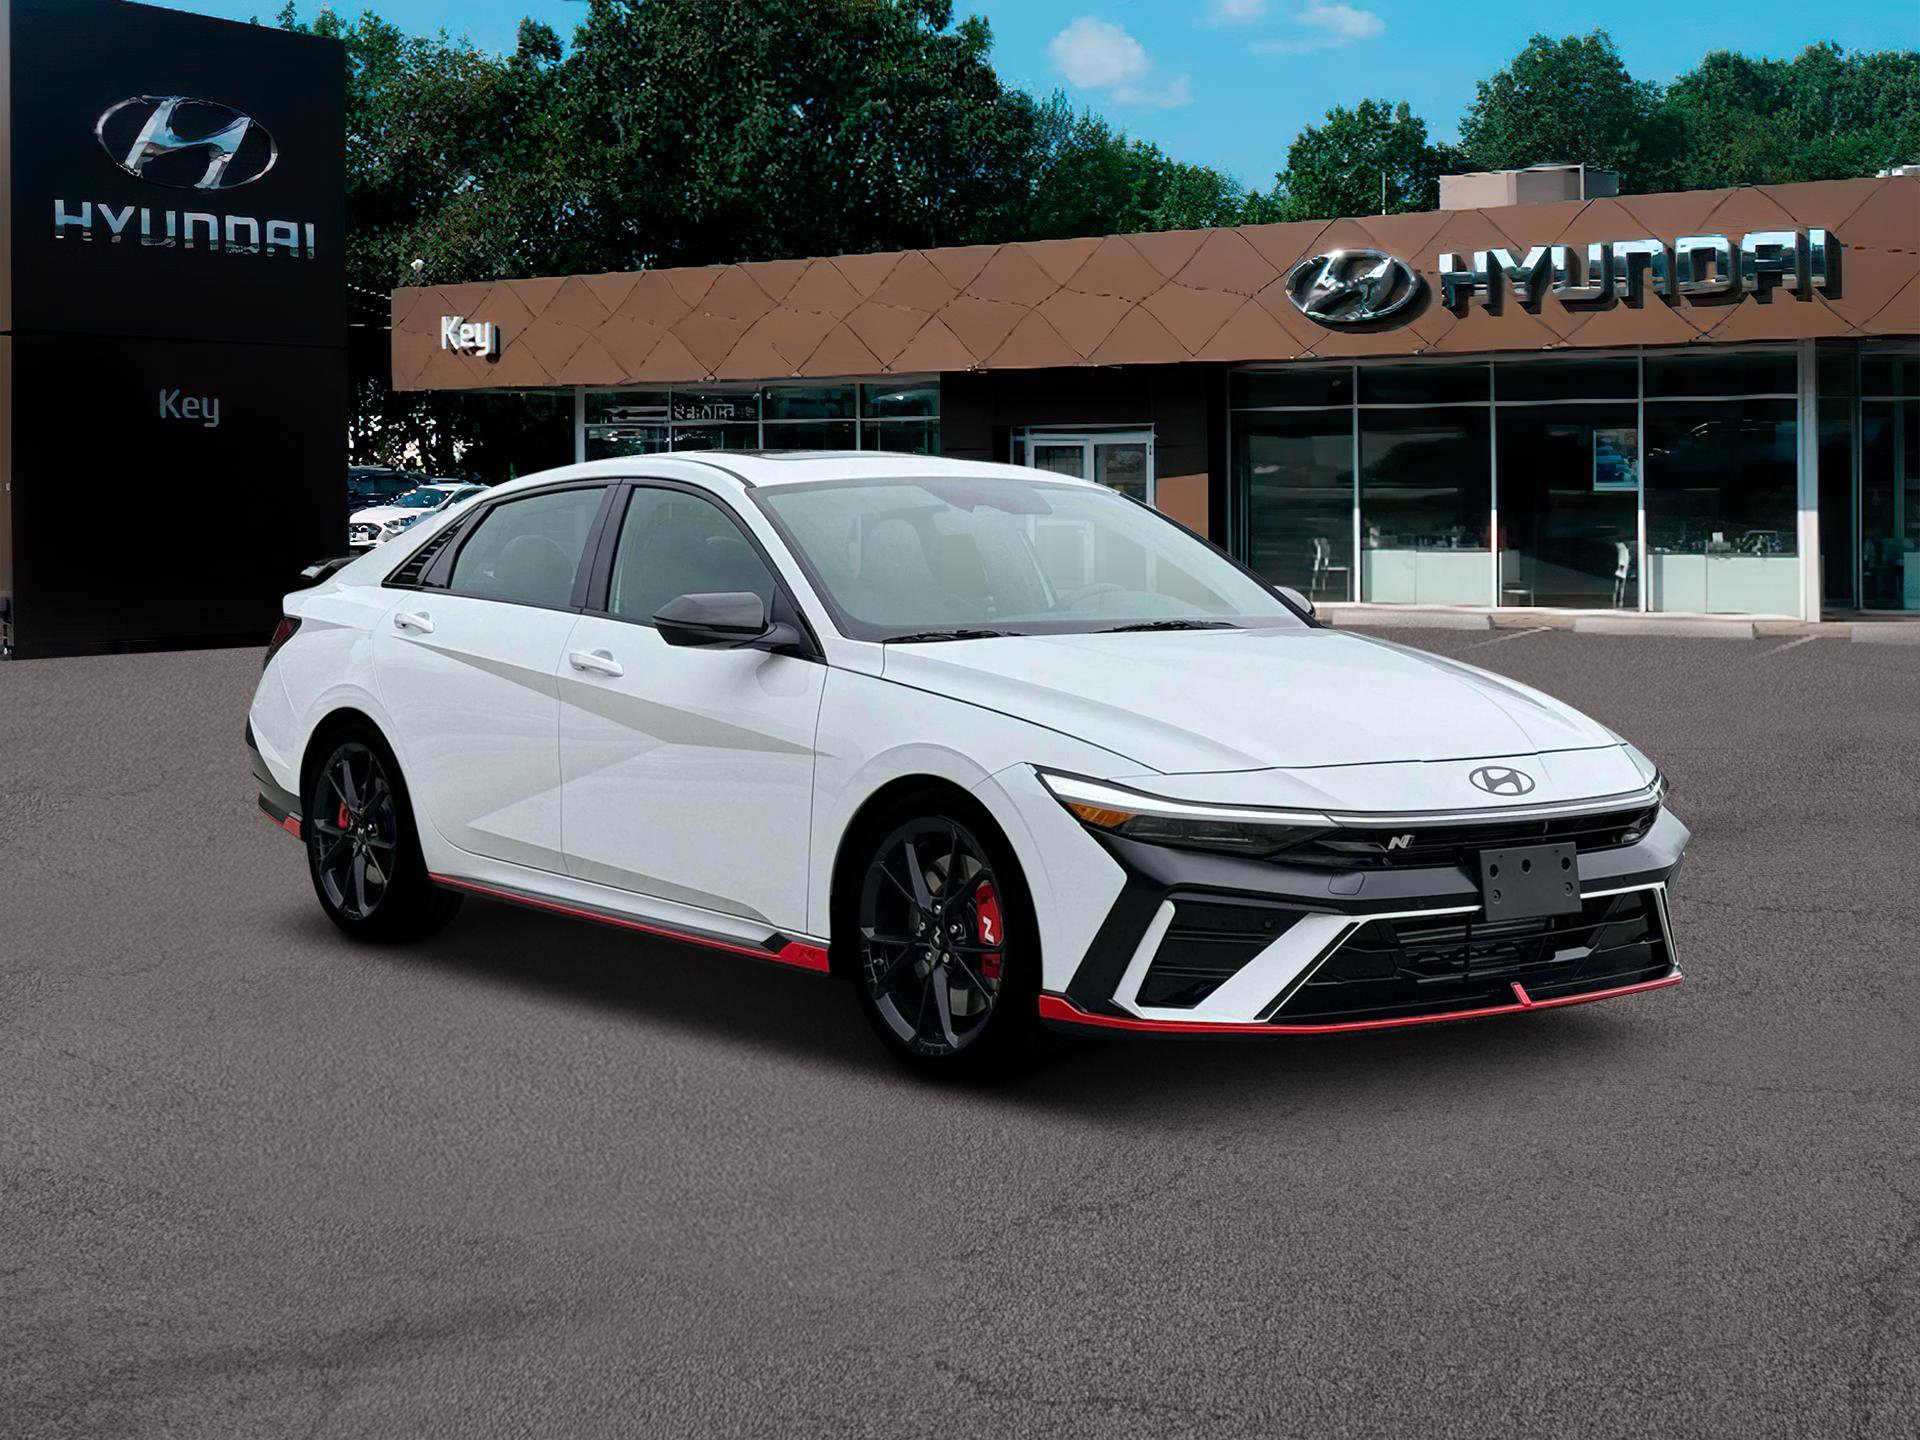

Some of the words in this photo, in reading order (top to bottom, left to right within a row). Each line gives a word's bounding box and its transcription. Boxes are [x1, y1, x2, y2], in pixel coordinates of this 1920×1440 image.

[54, 199, 315, 259] HYUNDAI
[1439, 228, 1837, 314] HYUNDAI
[441, 315, 491, 357] Key
[158, 388, 220, 428] Key
